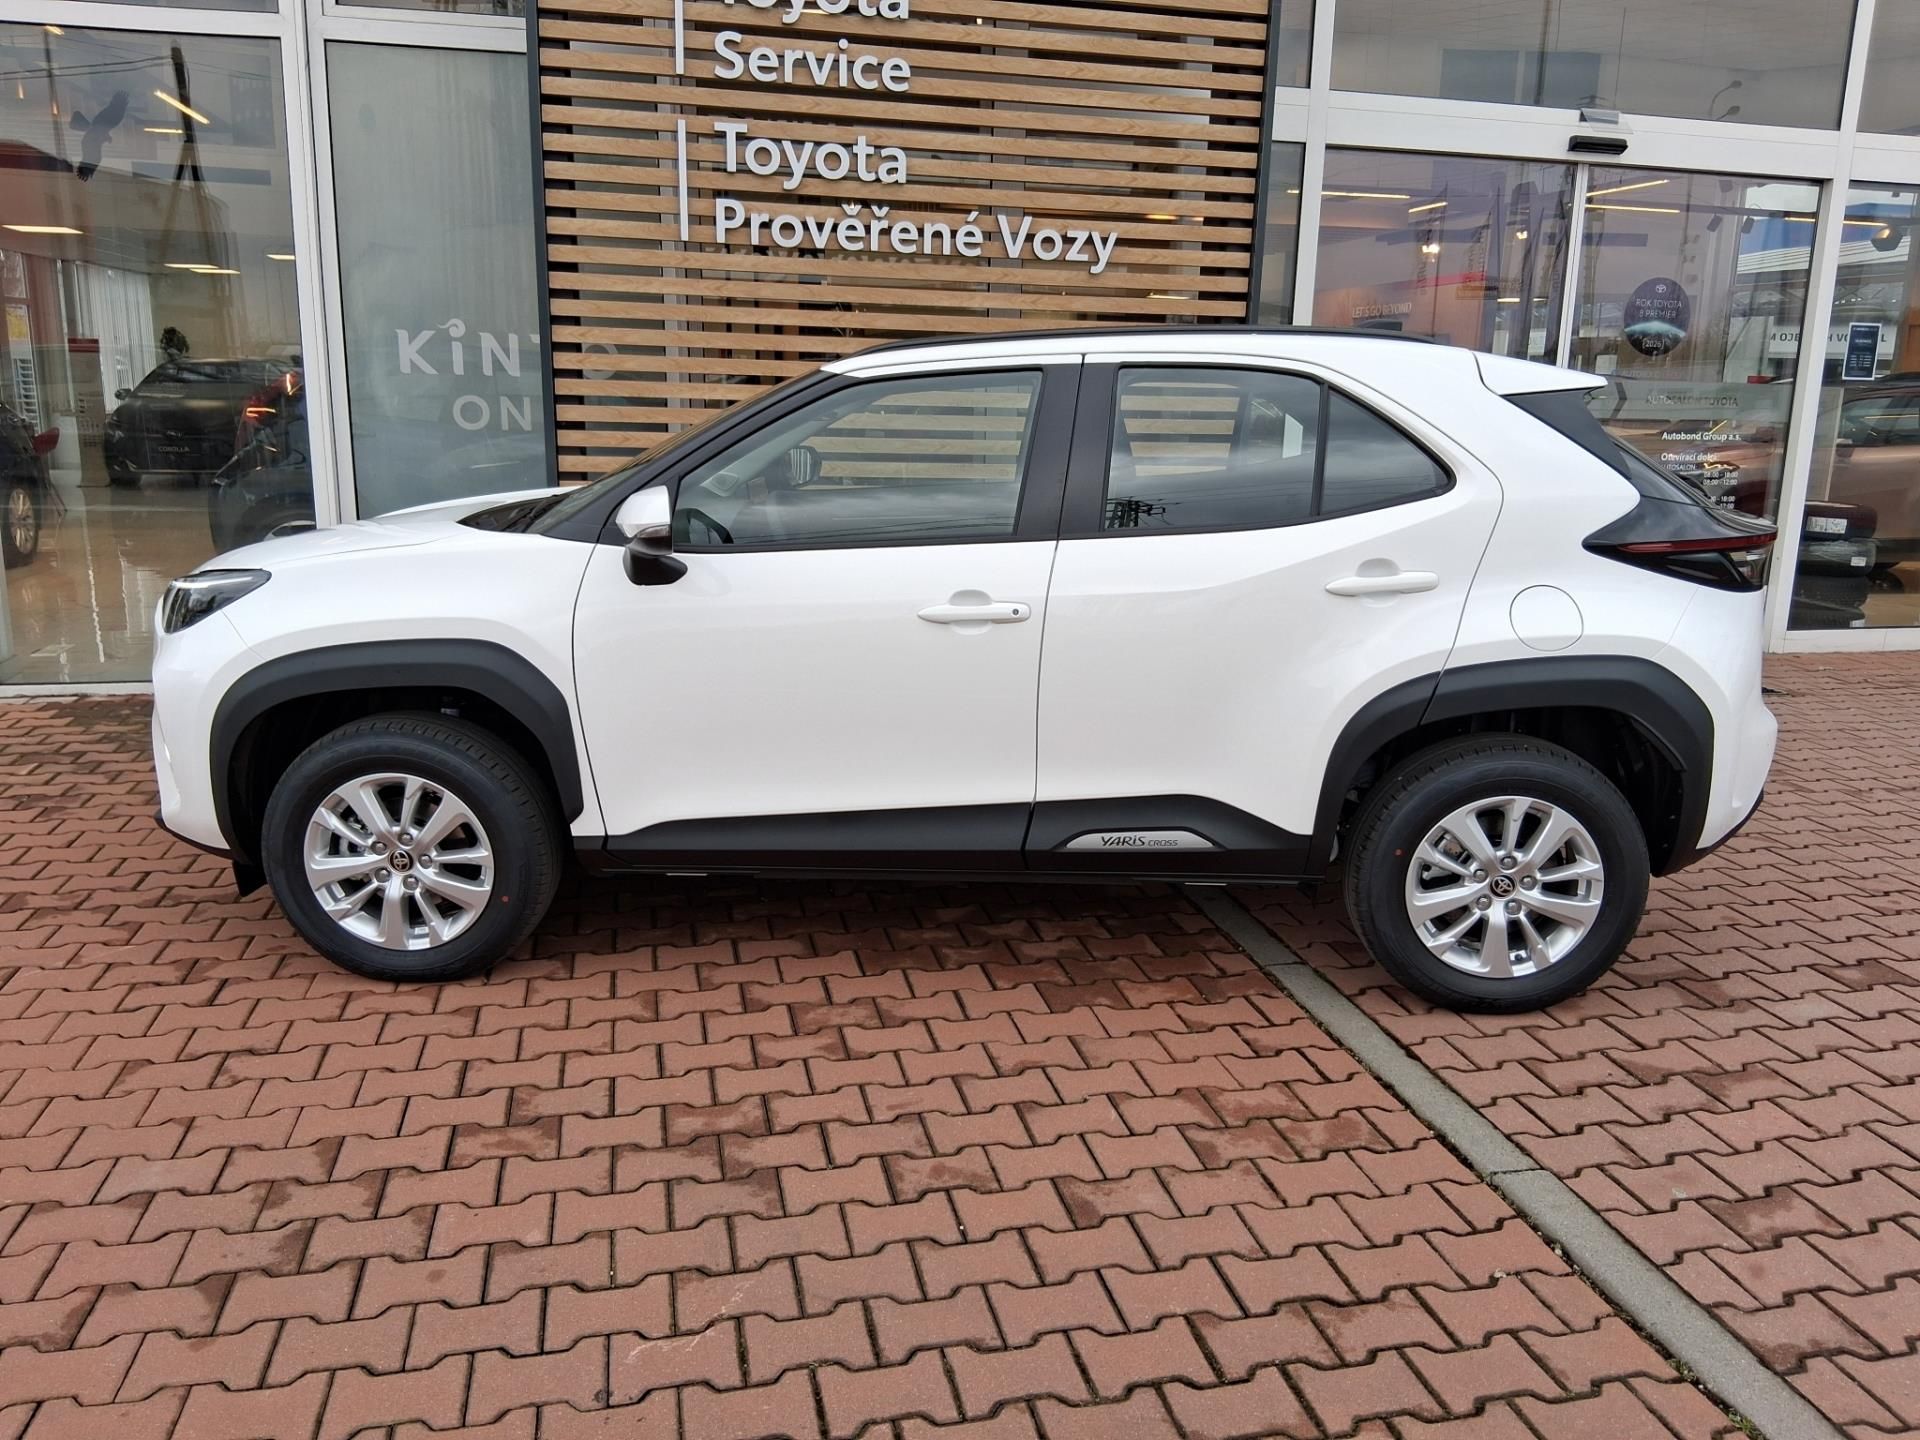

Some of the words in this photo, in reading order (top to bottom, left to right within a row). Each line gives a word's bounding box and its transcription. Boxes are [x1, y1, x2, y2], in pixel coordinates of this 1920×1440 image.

[713, 30, 911, 92] Service
[713, 121, 908, 191] Toyota
[714, 197, 983, 258] Prověřené
[996, 214, 1119, 274] Vozy
[1653, 299, 1682, 308] TOYOTA
[1661, 431, 1702, 441] Autobond
[1702, 432, 1727, 443] Group
[1728, 433, 1742, 441] a.s.
[1148, 839, 1179, 848] CROSS
